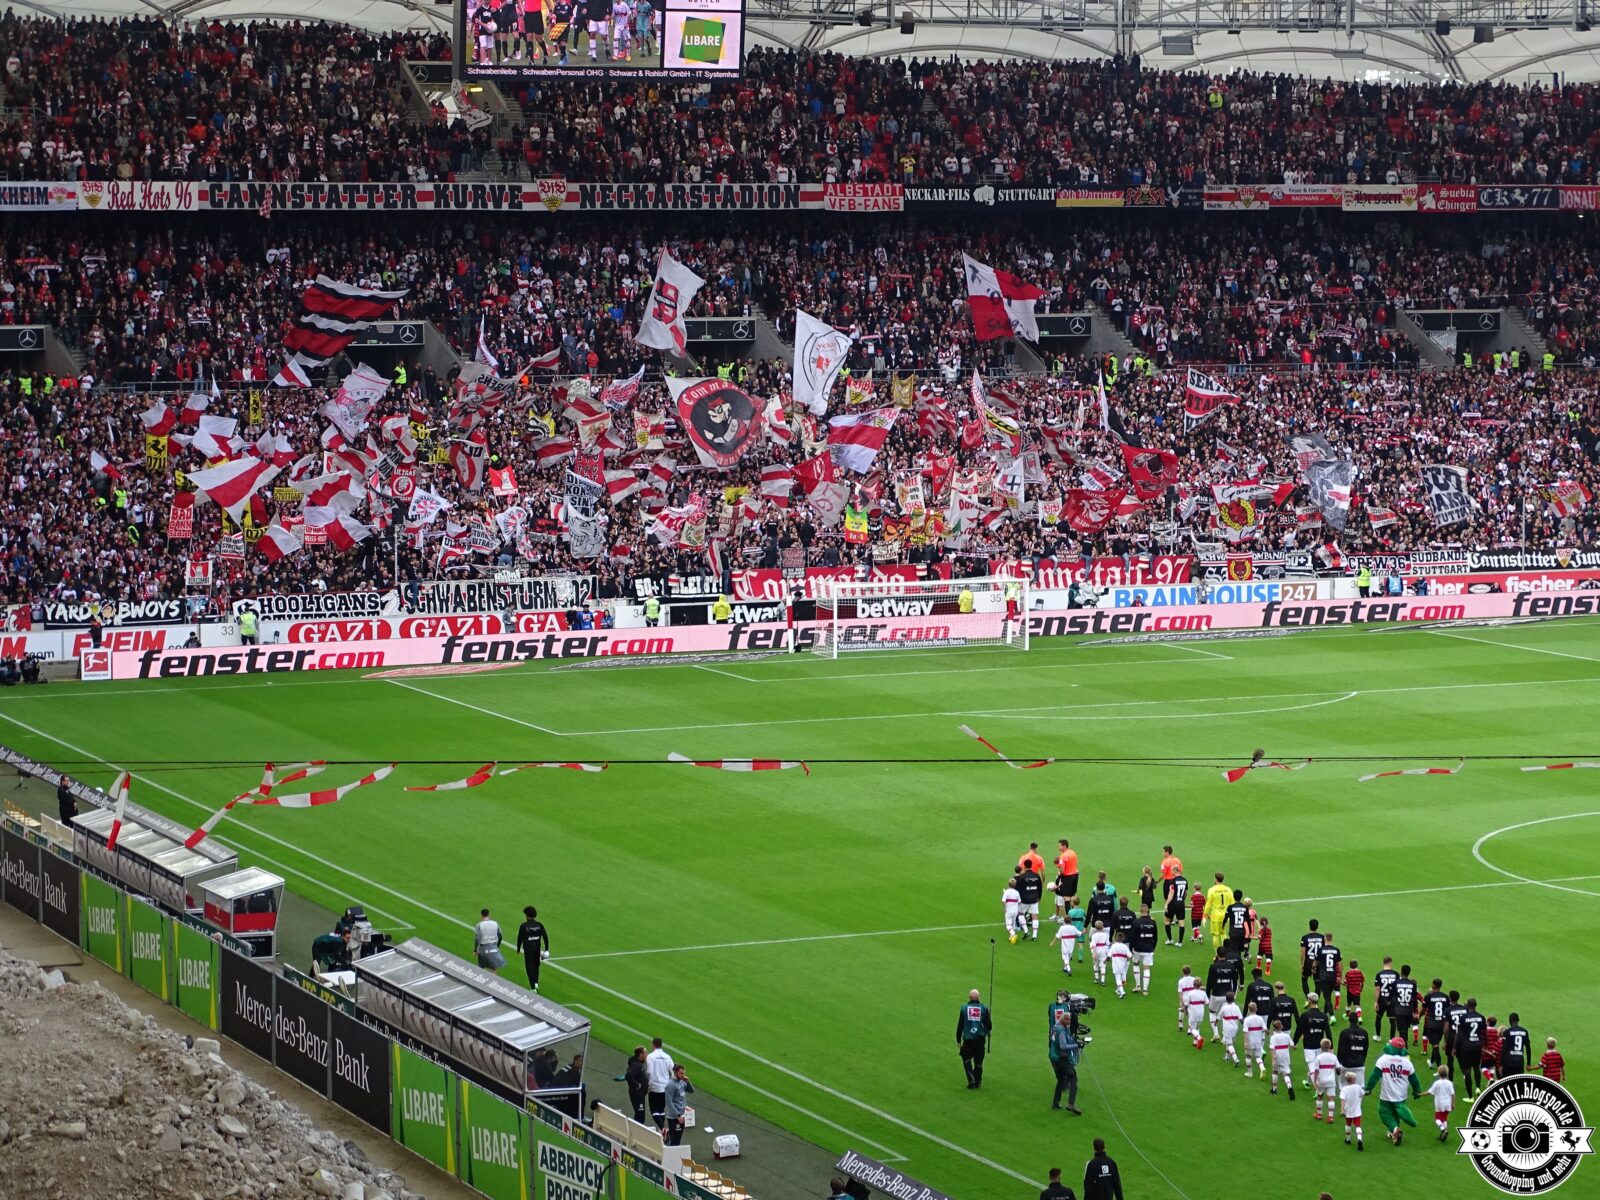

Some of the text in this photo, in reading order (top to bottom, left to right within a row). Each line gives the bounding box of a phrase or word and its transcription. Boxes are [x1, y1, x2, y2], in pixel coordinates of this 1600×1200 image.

[684, 35, 721, 47] LIBARE
[467, 67, 518, 76] Schwabenliebe
[609, 70, 638, 78] Schwarz
[669, 70, 691, 79] GmbH
[696, 71, 704, 79] IT
[107, 178, 136, 210] Red
[138, 178, 171, 210] Hots
[175, 178, 193, 210] 96
[209, 183, 417, 210] CANNSTATTER
[433, 183, 523, 210] KURVE
[579, 183, 801, 210] NECKARSTADION
[826, 183, 903, 197] ALBSTADT
[904, 188, 1057, 202] NECKAR-FILS STUTTGART
[1059, 188, 1118, 200] Old Warriors
[1531, 188, 1553, 206] 77
[1558, 189, 1596, 209] DONAU
[828, 197, 901, 210] VFB-FANS
[1469, 550, 1558, 569] Cannstatter
[1155, 557, 1190, 585] 97
[1412, 564, 1469, 576] STUTTGART
[1283, 585, 1316, 601] 247
[1505, 575, 1575, 593] fischer
[260, 593, 380, 614] HOOLIGANS
[990, 593, 1002, 603] 35
[44, 597, 181, 623] YARD BWOYS
[856, 598, 935, 619] betway
[1262, 600, 1467, 627] fenster.com
[221, 625, 235, 636] 33
[1001, 610, 1213, 638] fenster.com
[729, 622, 950, 651] fenster.com
[0, 636, 27, 661] M
[441, 634, 674, 664] fenster.com
[138, 648, 385, 679] fenster.com
[0, 851, 68, 914] des-Benz Bank
[1176, 885, 1186, 897] 17
[1220, 893, 1224, 906] 1
[88, 905, 116, 935] LIBARE
[1233, 911, 1244, 924] 15
[132, 931, 162, 961] LIBARE
[1326, 953, 1334, 968] 6
[179, 957, 210, 989] LIBARE
[1397, 987, 1413, 1003] 36
[1434, 1002, 1443, 1017] 8
[1470, 1022, 1479, 1037] 2
[1514, 1036, 1523, 1051] 9
[335, 1038, 370, 1093] Bank
[403, 1087, 446, 1127] LIBARE
[471, 1126, 519, 1169] LIBARE
[539, 1144, 604, 1191] ABBRUCH
[836, 1150, 917, 1200] Mercedes-Benz
